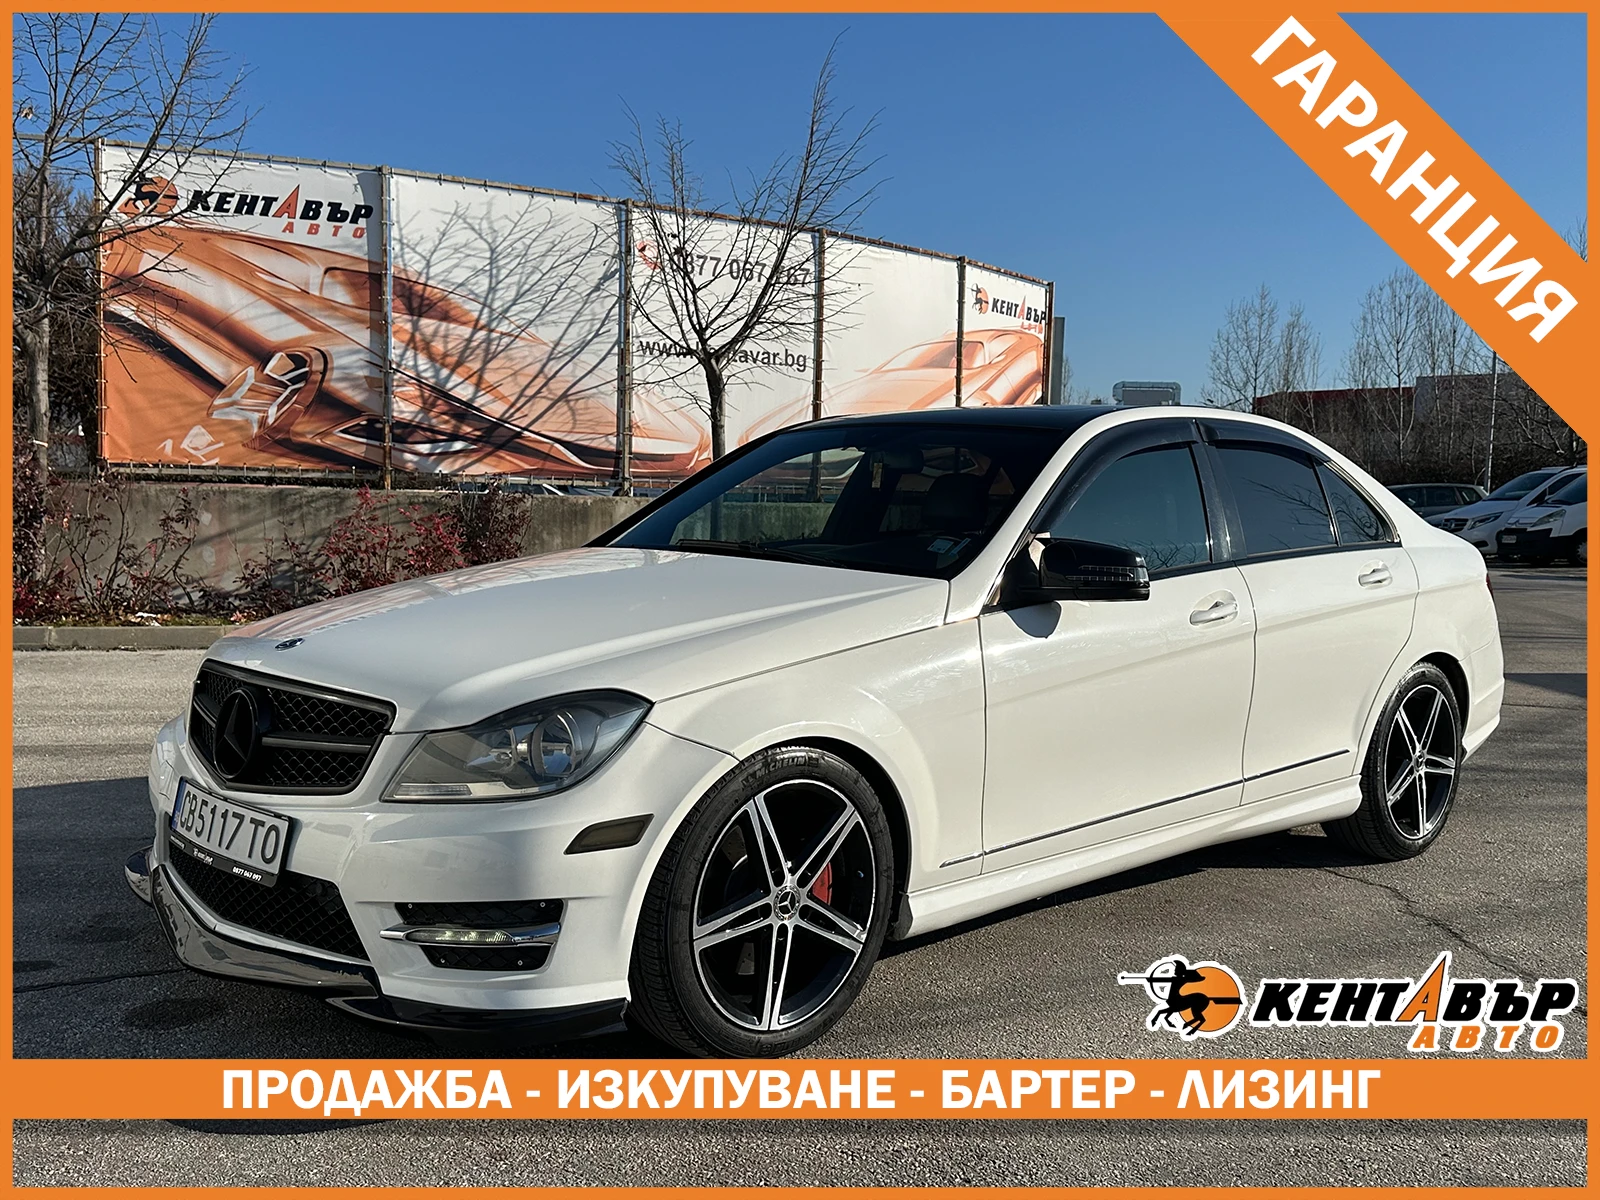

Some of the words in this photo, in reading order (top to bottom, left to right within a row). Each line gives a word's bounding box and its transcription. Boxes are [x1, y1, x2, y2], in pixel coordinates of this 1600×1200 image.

[189, 184, 374, 225] КЕНТАВЪР
[282, 221, 367, 239] АВТО
[991, 295, 1047, 325] КЕНТАВЪР
[755, 756, 807, 780] MICHELIN
